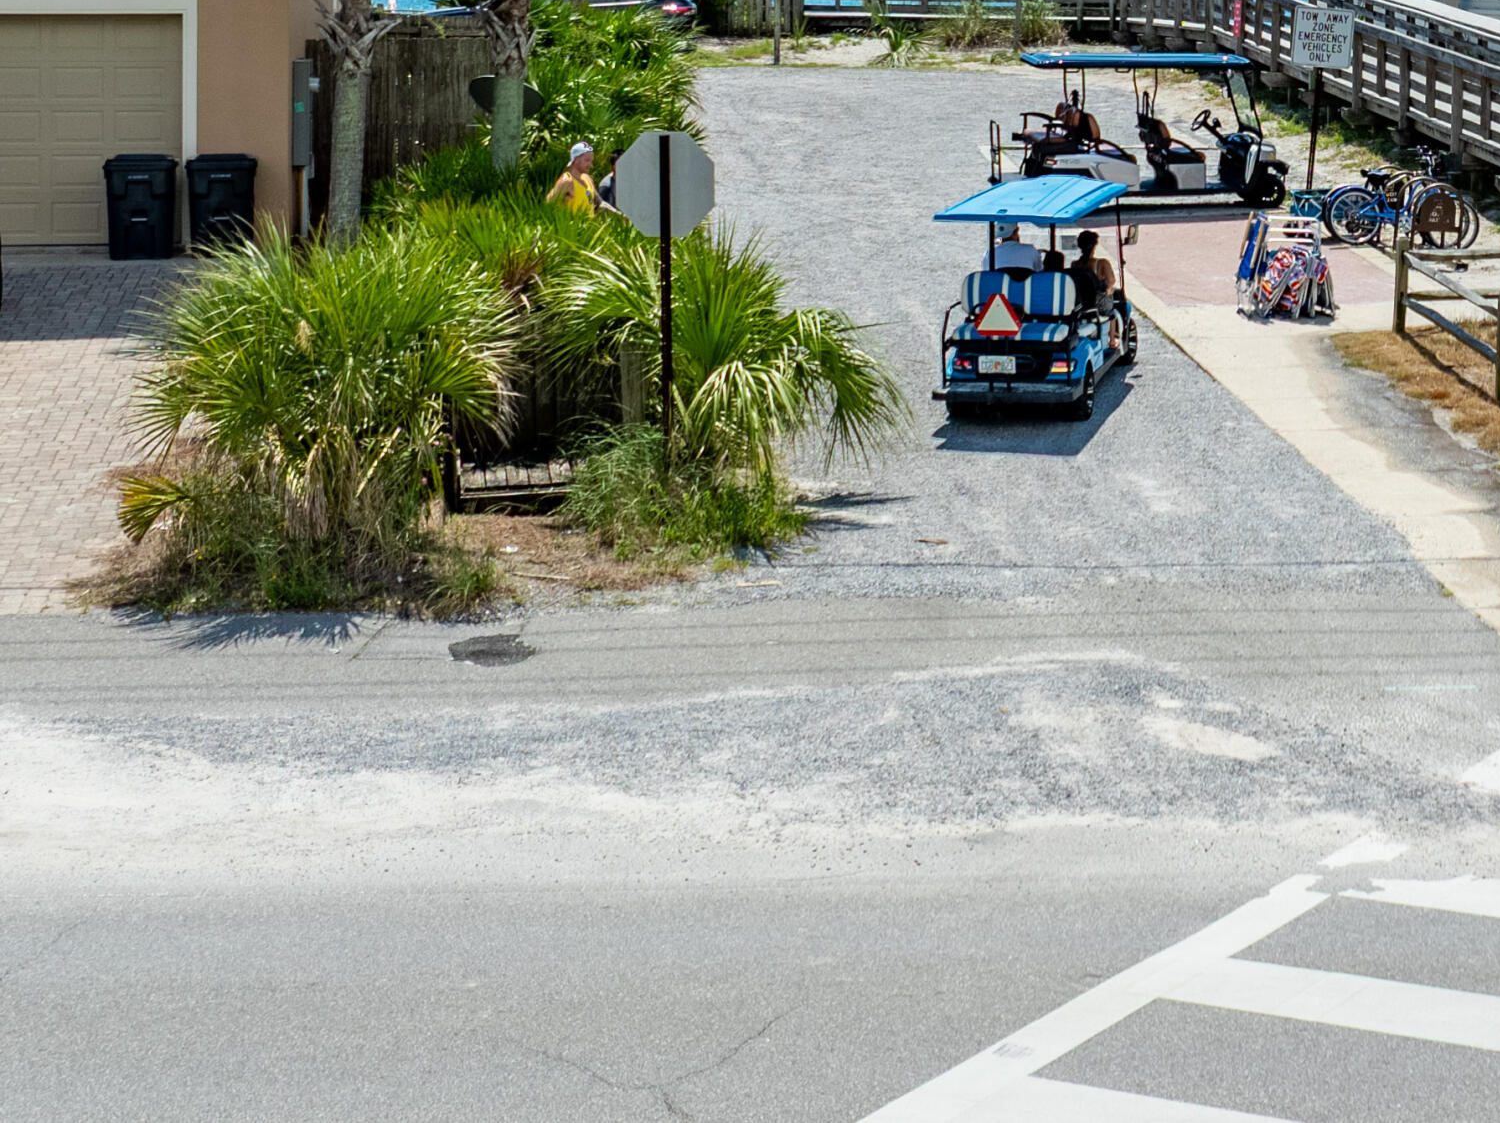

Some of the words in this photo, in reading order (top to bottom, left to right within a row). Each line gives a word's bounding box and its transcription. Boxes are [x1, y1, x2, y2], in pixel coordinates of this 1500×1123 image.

[1301, 11, 1318, 21] TOW
[1327, 14, 1349, 24] AWAY
[1312, 22, 1335, 33] ZONE
[1298, 31, 1348, 44] EMERGENCY
[1302, 42, 1342, 53] VEHICLES
[1309, 52, 1332, 62] ONLY
